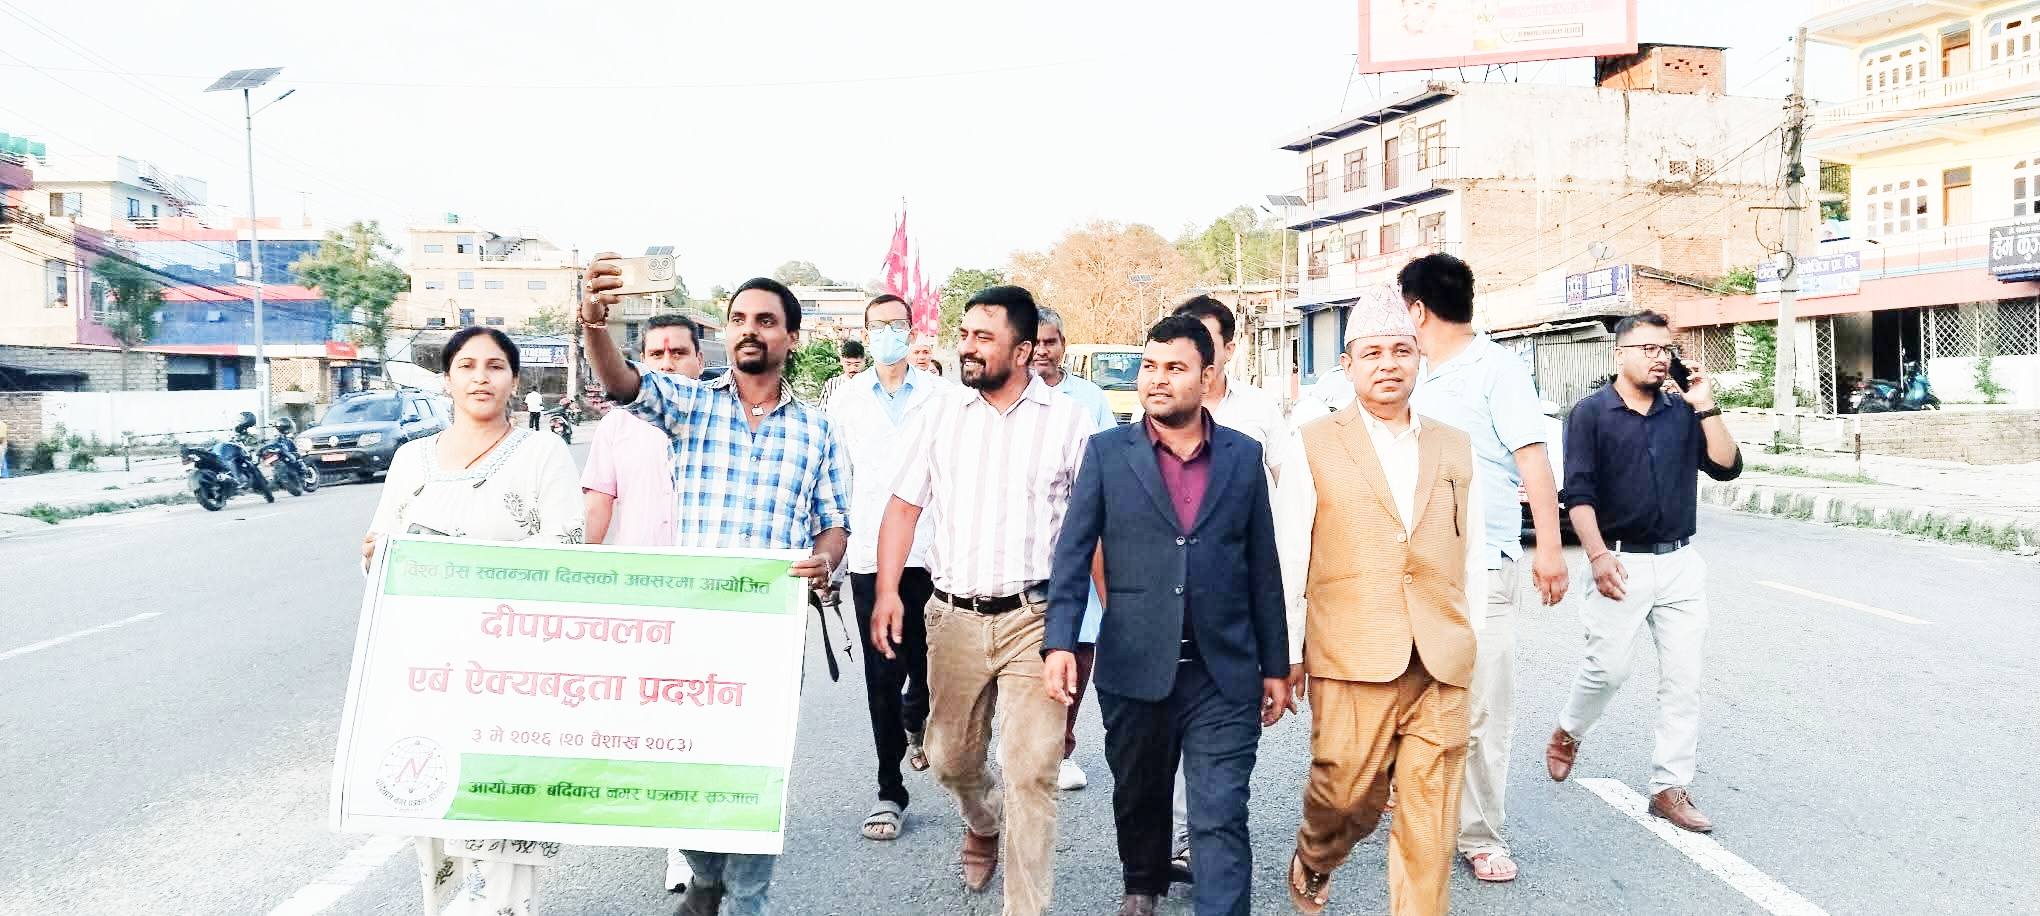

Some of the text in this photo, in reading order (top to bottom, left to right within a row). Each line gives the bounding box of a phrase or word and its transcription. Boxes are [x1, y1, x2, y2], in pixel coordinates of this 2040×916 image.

[1097, 353, 1142, 361] MONTESSO
[402, 560, 772, 595] विश्व प्रेस स्वतन्त्रता दिवसको अवसरमा आयोजित
[480, 603, 676, 645] दीपप्रज्वलन
[465, 660, 627, 707] ऐक्यबद्धता
[638, 673, 747, 707] प्रदर्शन
[471, 725, 693, 752] ३ मे २०२६ (२० वैशाख २०८३)
[606, 787, 642, 800] नगर
[646, 788, 698, 803] पत्रकार
